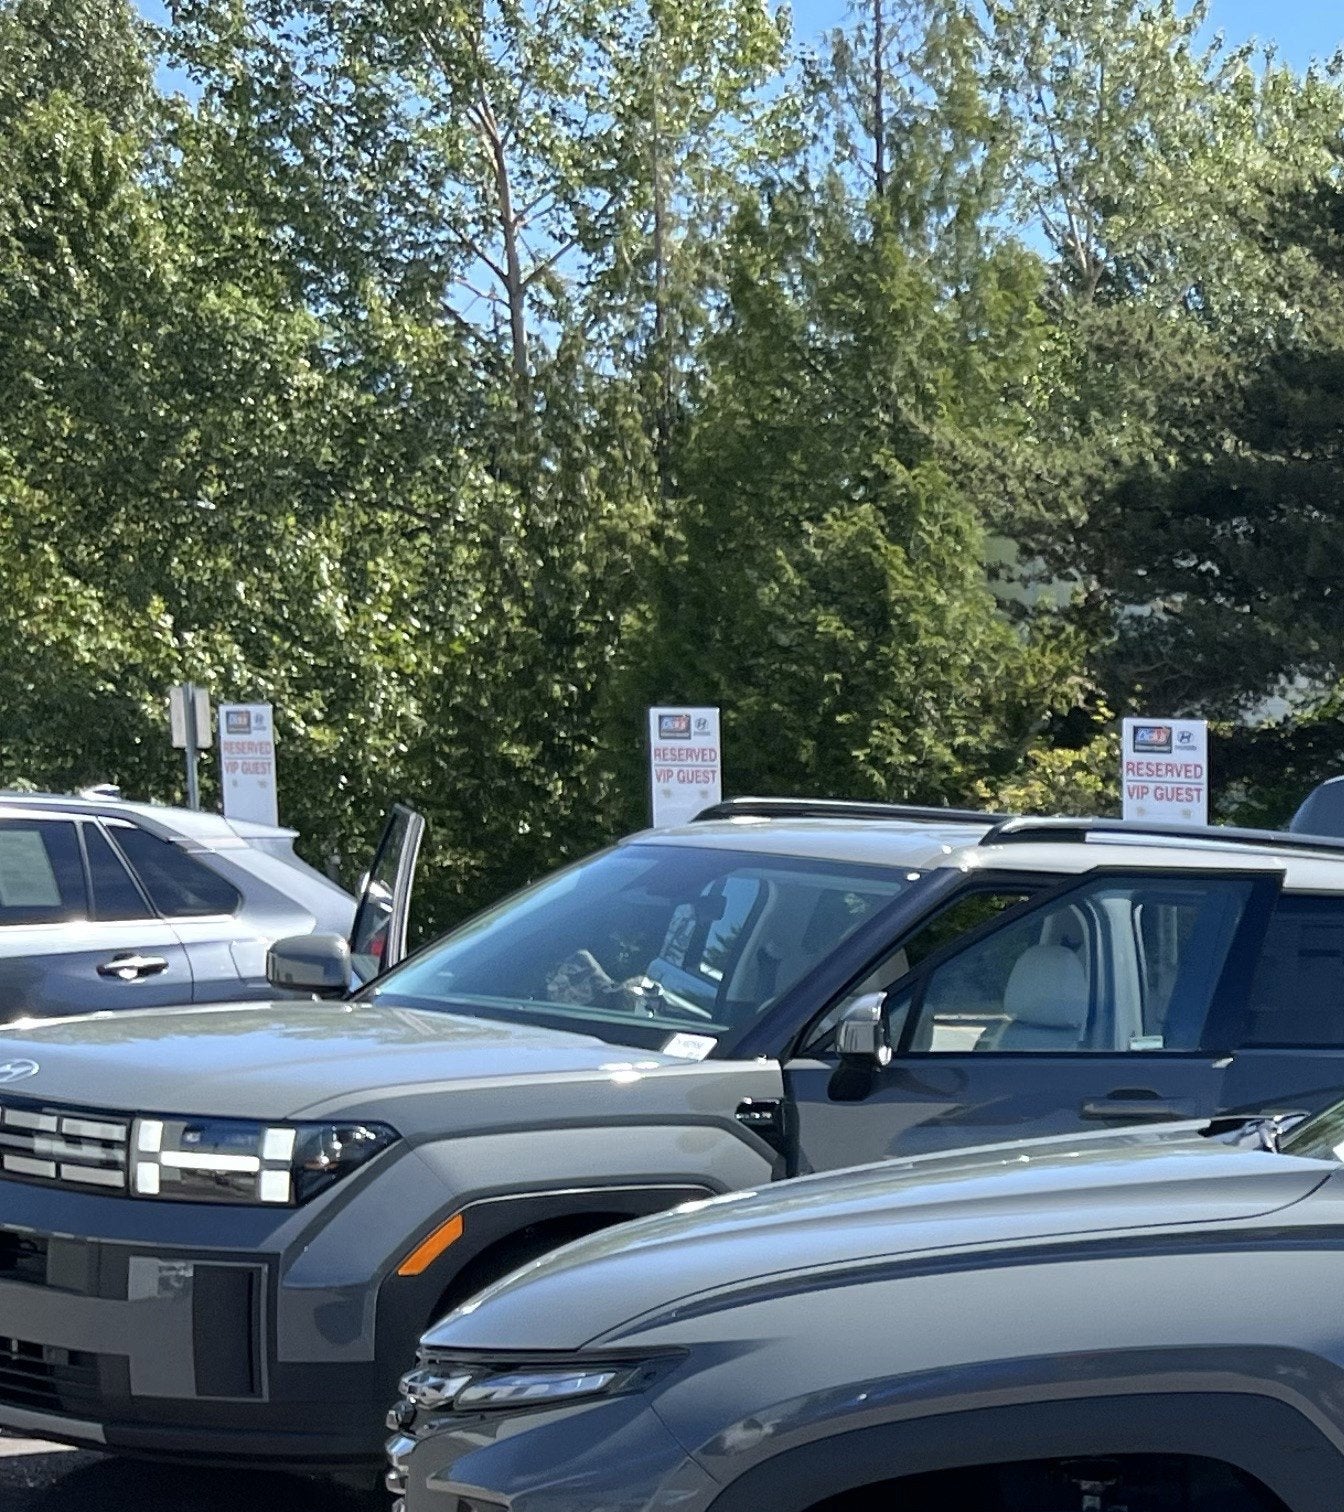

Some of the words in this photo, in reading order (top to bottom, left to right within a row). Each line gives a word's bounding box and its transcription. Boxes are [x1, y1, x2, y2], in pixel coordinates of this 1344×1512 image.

[223, 741, 272, 756] RESERVED
[653, 747, 718, 763] RESERVED
[224, 761, 239, 776] VIP
[241, 761, 272, 776] GUEST
[655, 768, 674, 785] VIP
[677, 769, 718, 785] GUEST
[1125, 761, 1204, 780] RESERVED
[1126, 784, 1149, 801] VIP
[1154, 785, 1203, 803] GUEST
